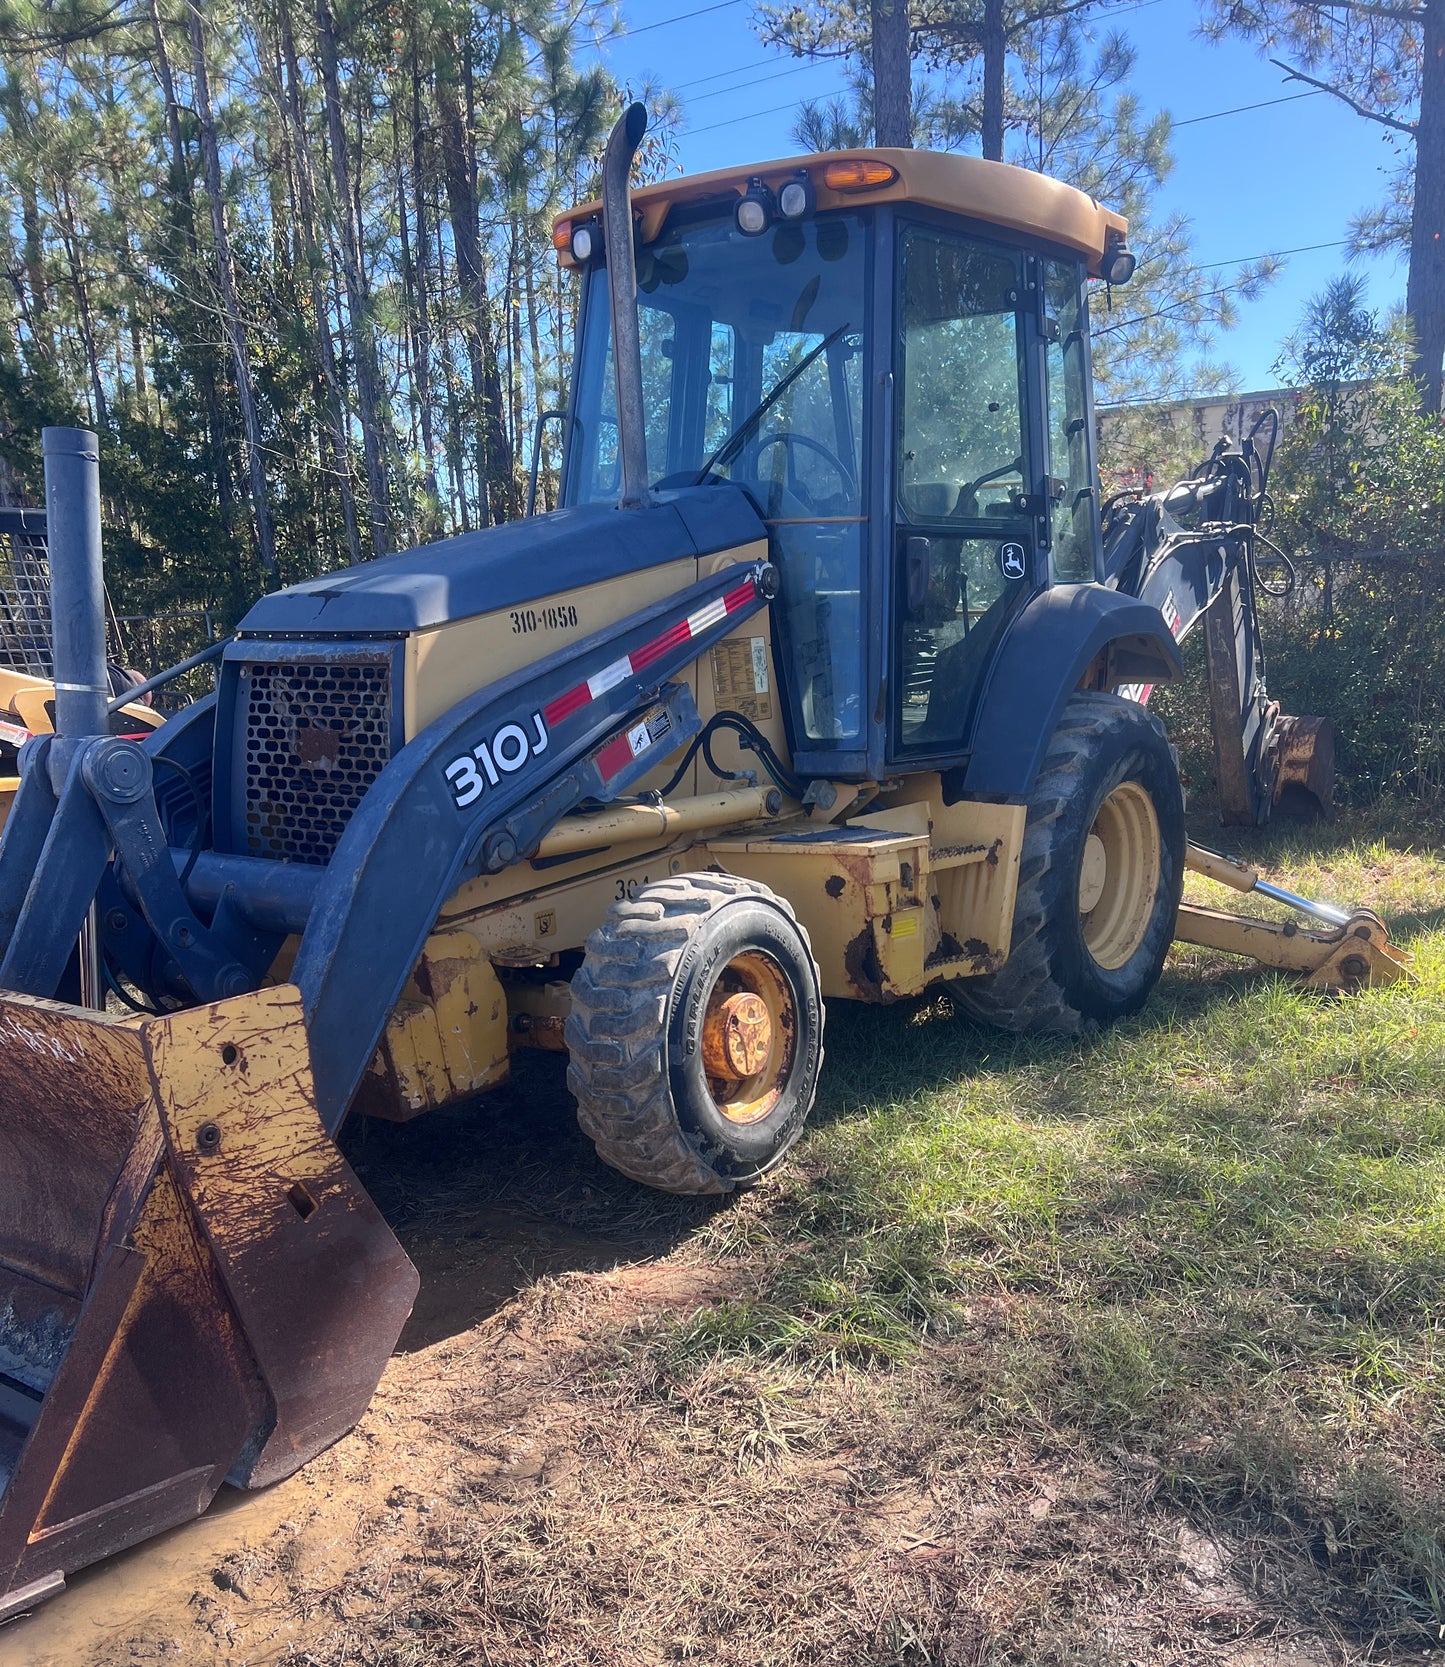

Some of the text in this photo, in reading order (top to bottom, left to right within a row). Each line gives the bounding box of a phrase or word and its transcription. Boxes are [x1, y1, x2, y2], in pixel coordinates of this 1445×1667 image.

[510, 605, 578, 634] 310-1858
[445, 713, 548, 807] 310J
[685, 941, 722, 1056] CARLISLE
[806, 997, 818, 1074] GUARD
